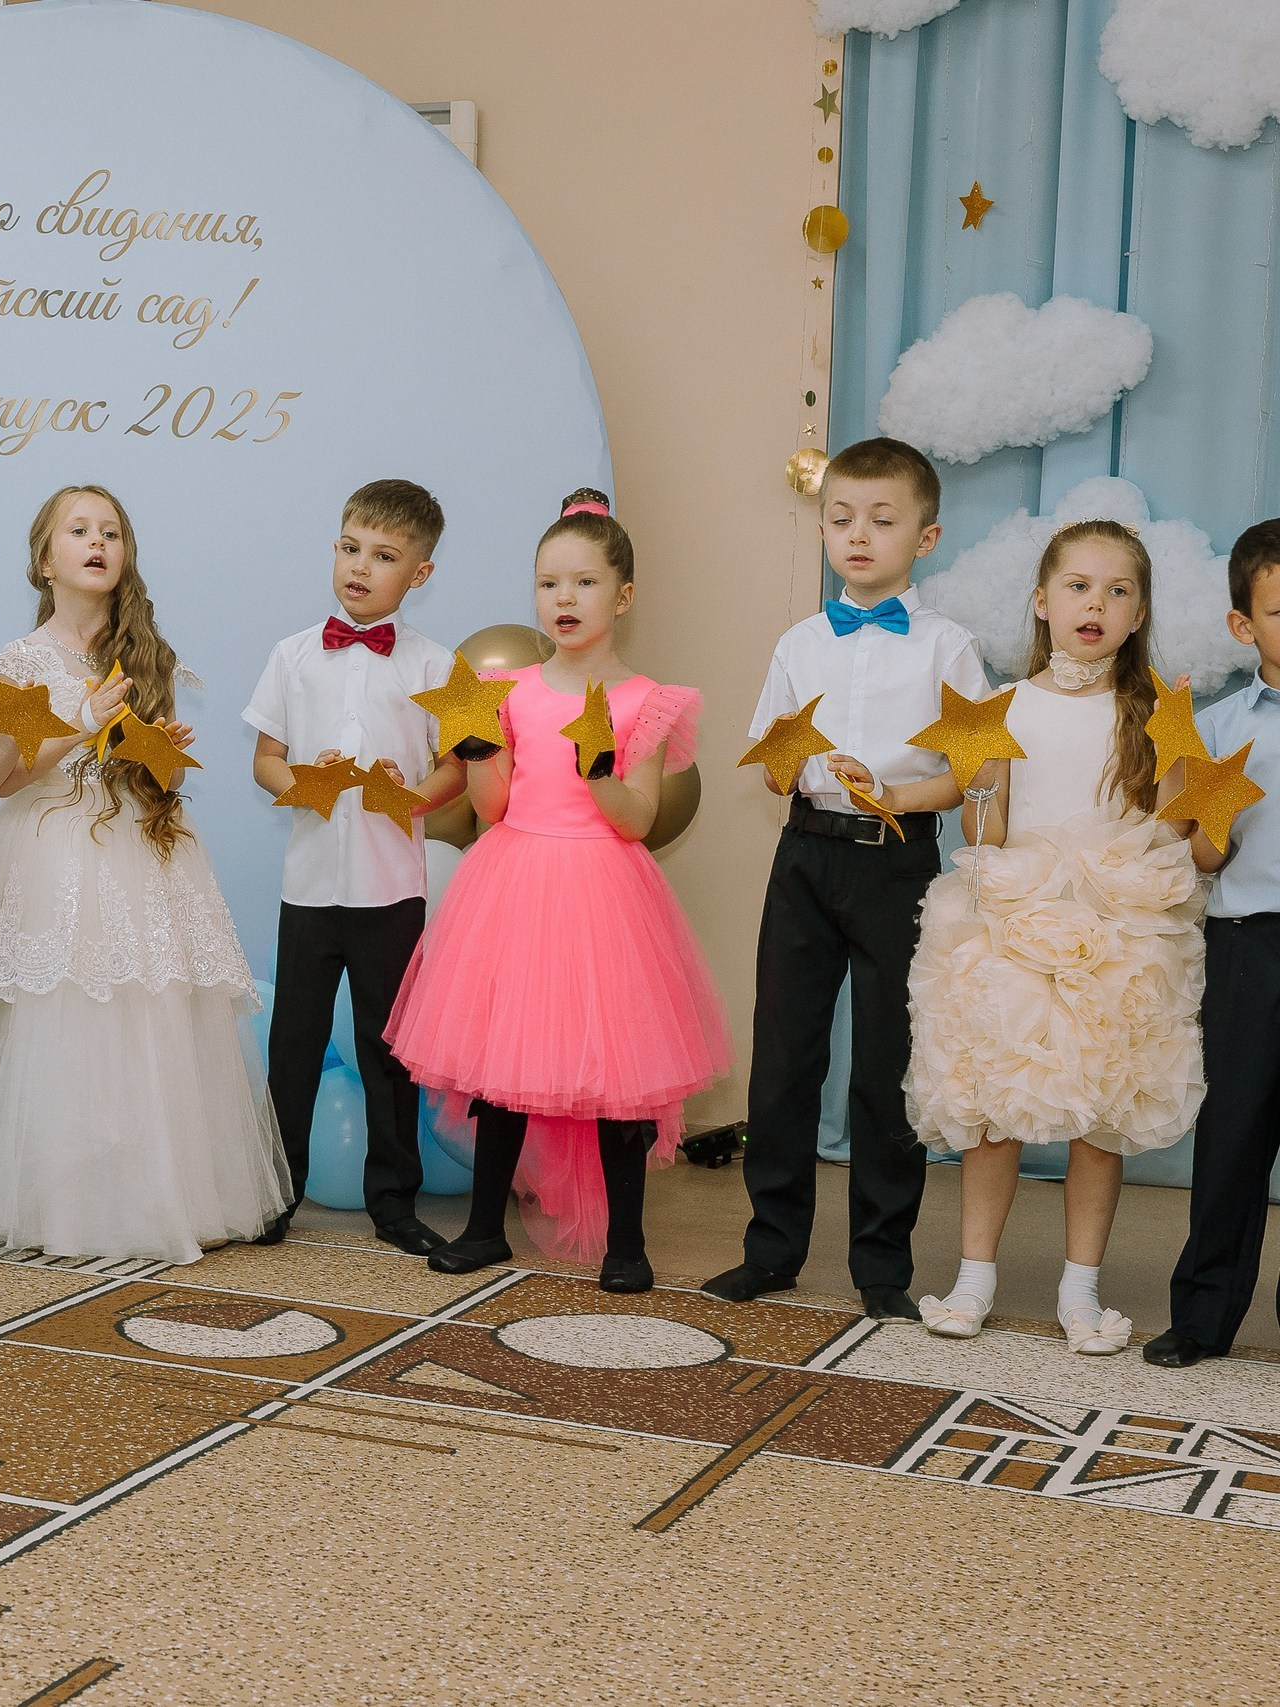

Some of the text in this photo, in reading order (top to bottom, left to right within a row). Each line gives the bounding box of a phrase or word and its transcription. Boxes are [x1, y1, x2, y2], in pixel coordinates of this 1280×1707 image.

[35, 168, 264, 262] свидания,
[136, 277, 261, 350] сад!
[123, 383, 303, 443] 2025
